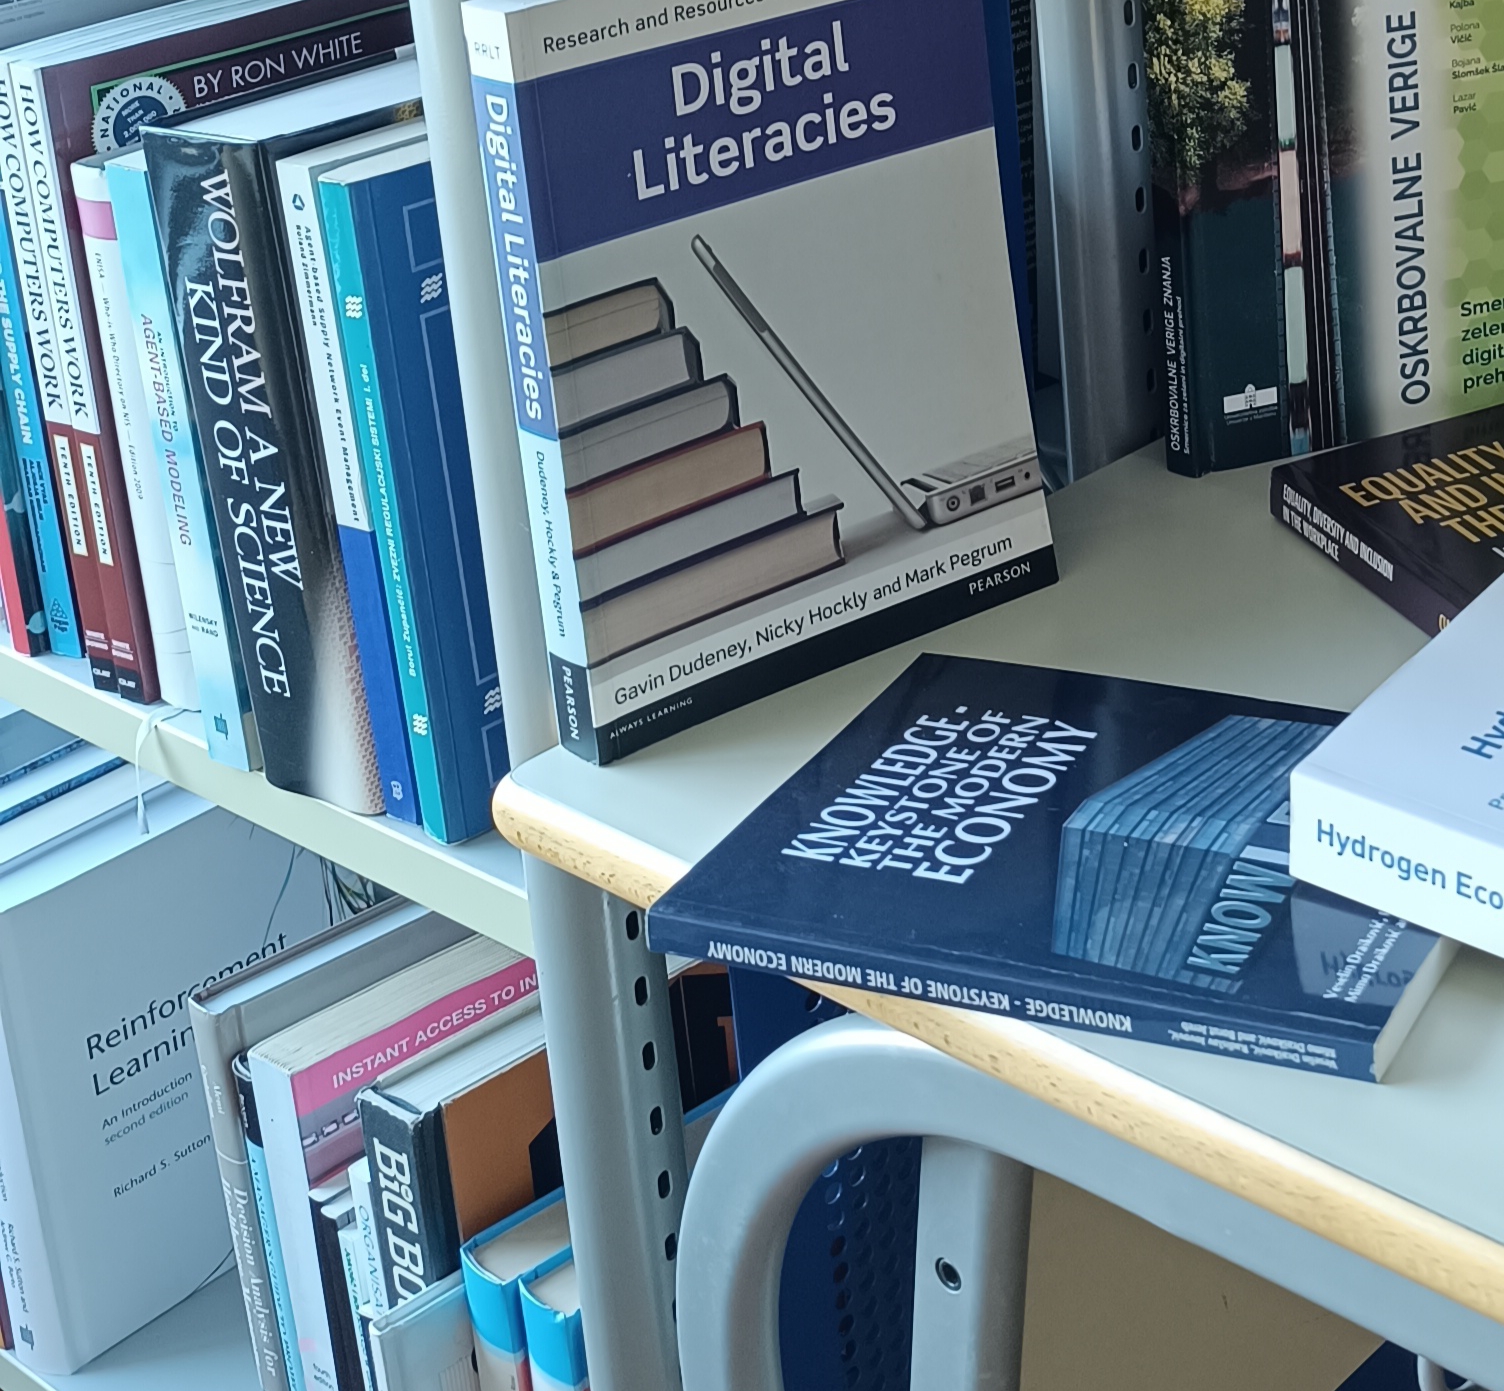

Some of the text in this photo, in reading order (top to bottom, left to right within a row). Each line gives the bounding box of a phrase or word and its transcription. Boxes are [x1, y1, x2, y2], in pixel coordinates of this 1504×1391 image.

[193, 31, 363, 98] BY RON WHITE
[544, 19, 630, 54] Research
[635, 9, 669, 31] and
[671, 20, 849, 116] Digital
[1386, 11, 1421, 141] VERIGE
[633, 90, 896, 201] Literacies
[19, 84, 88, 419] HOW COMPUTERS WORK
[485, 94, 542, 420] Digital Literacies
[1392, 152, 1431, 405] OSKRBOVALNE
[201, 170, 303, 590] WOLFRAM A NEW
[184, 277, 292, 698] KIND OF SCIENCE
[1399, 472, 1488, 524] AND
[615, 536, 1012, 705] Gavin Dudeney, Nicky Hockly and Mark Pegrum
[968, 560, 1031, 595] PEARSON
[782, 715, 970, 861] KNOWLEDGE
[839, 710, 1011, 868] KEYSTONE OF
[876, 715, 1049, 870] THE MODERN
[912, 720, 1097, 884] ECONOMY
[1317, 819, 1447, 891] Hydrogen
[101, 1072, 193, 1130] An Introduction
[332, 986, 515, 1088] INSTANT ACCESS TO
